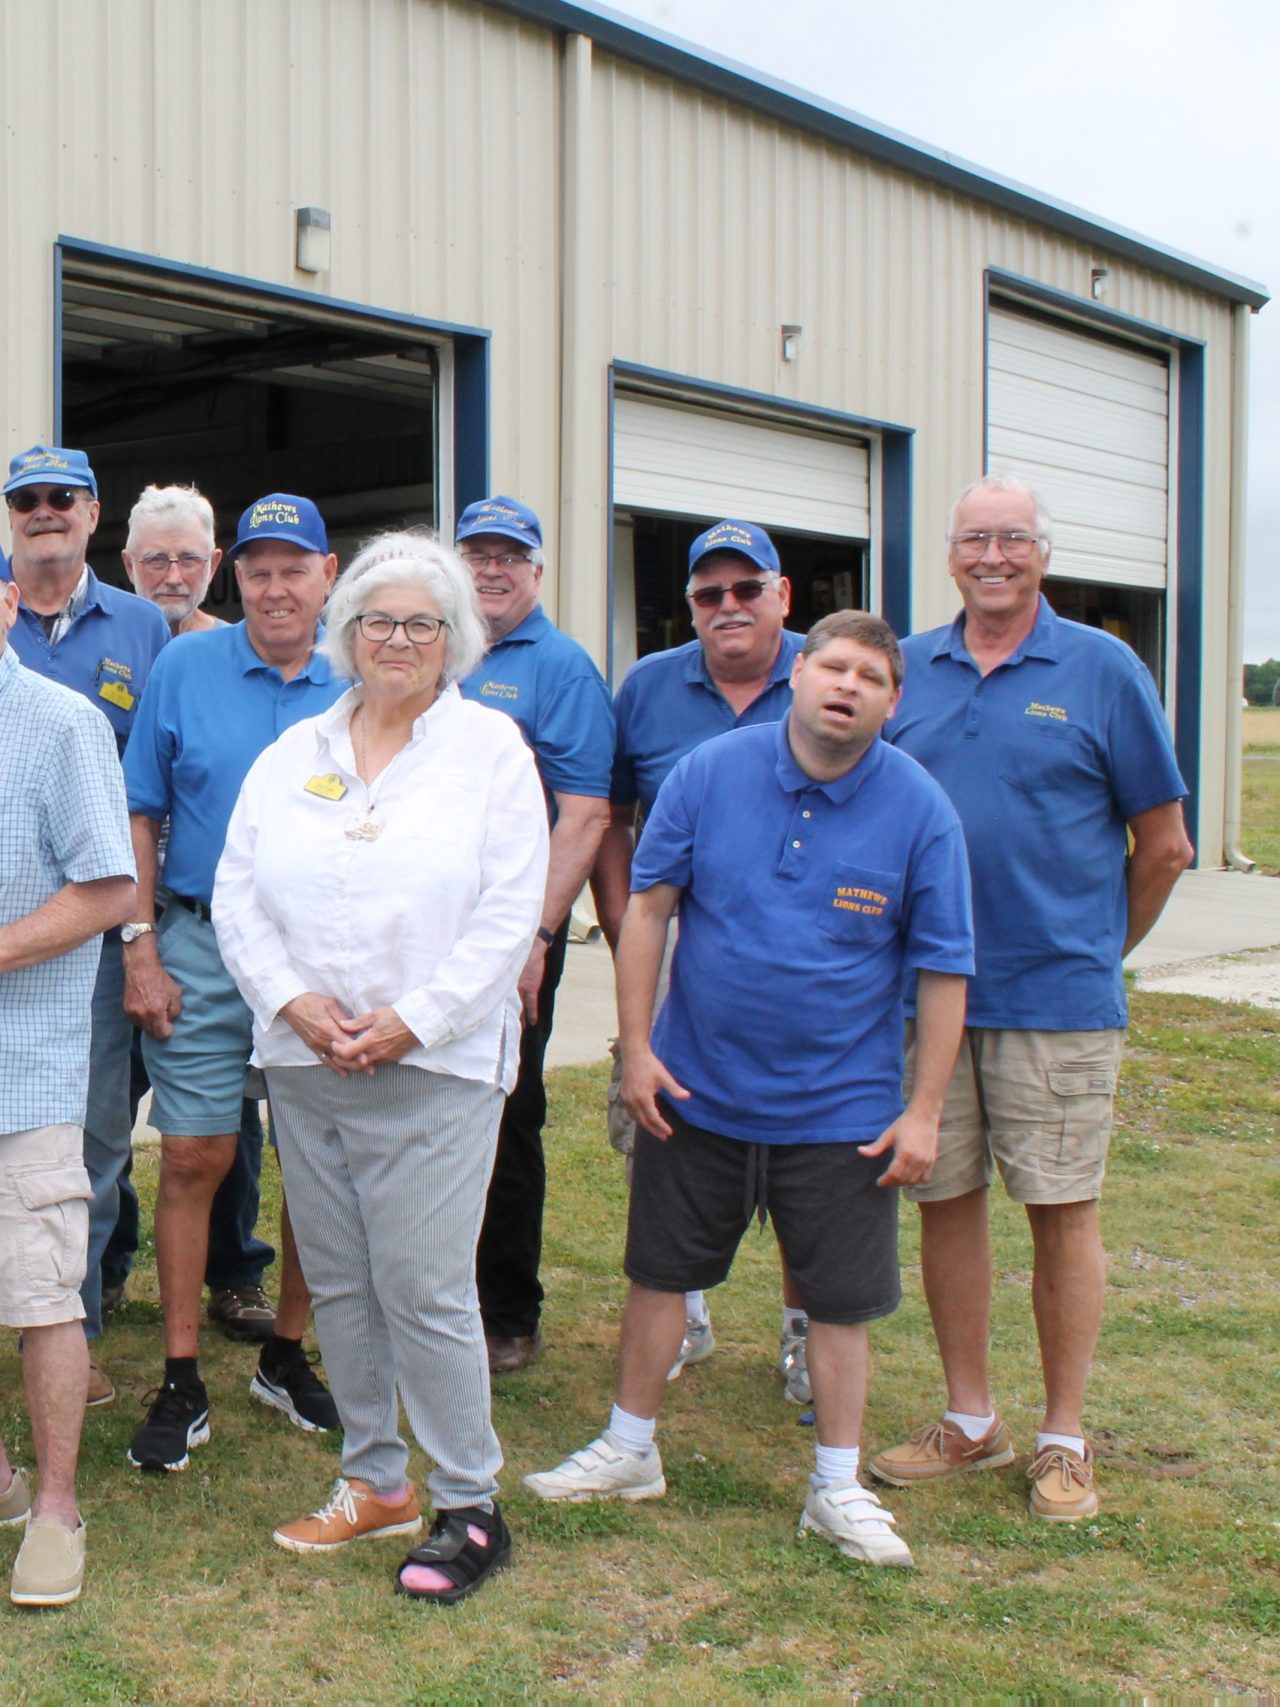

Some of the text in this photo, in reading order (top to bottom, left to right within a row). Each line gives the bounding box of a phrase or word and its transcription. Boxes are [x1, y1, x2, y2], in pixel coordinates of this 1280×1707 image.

[254, 501, 297, 514] Mathews
[249, 511, 300, 528] Lions Club
